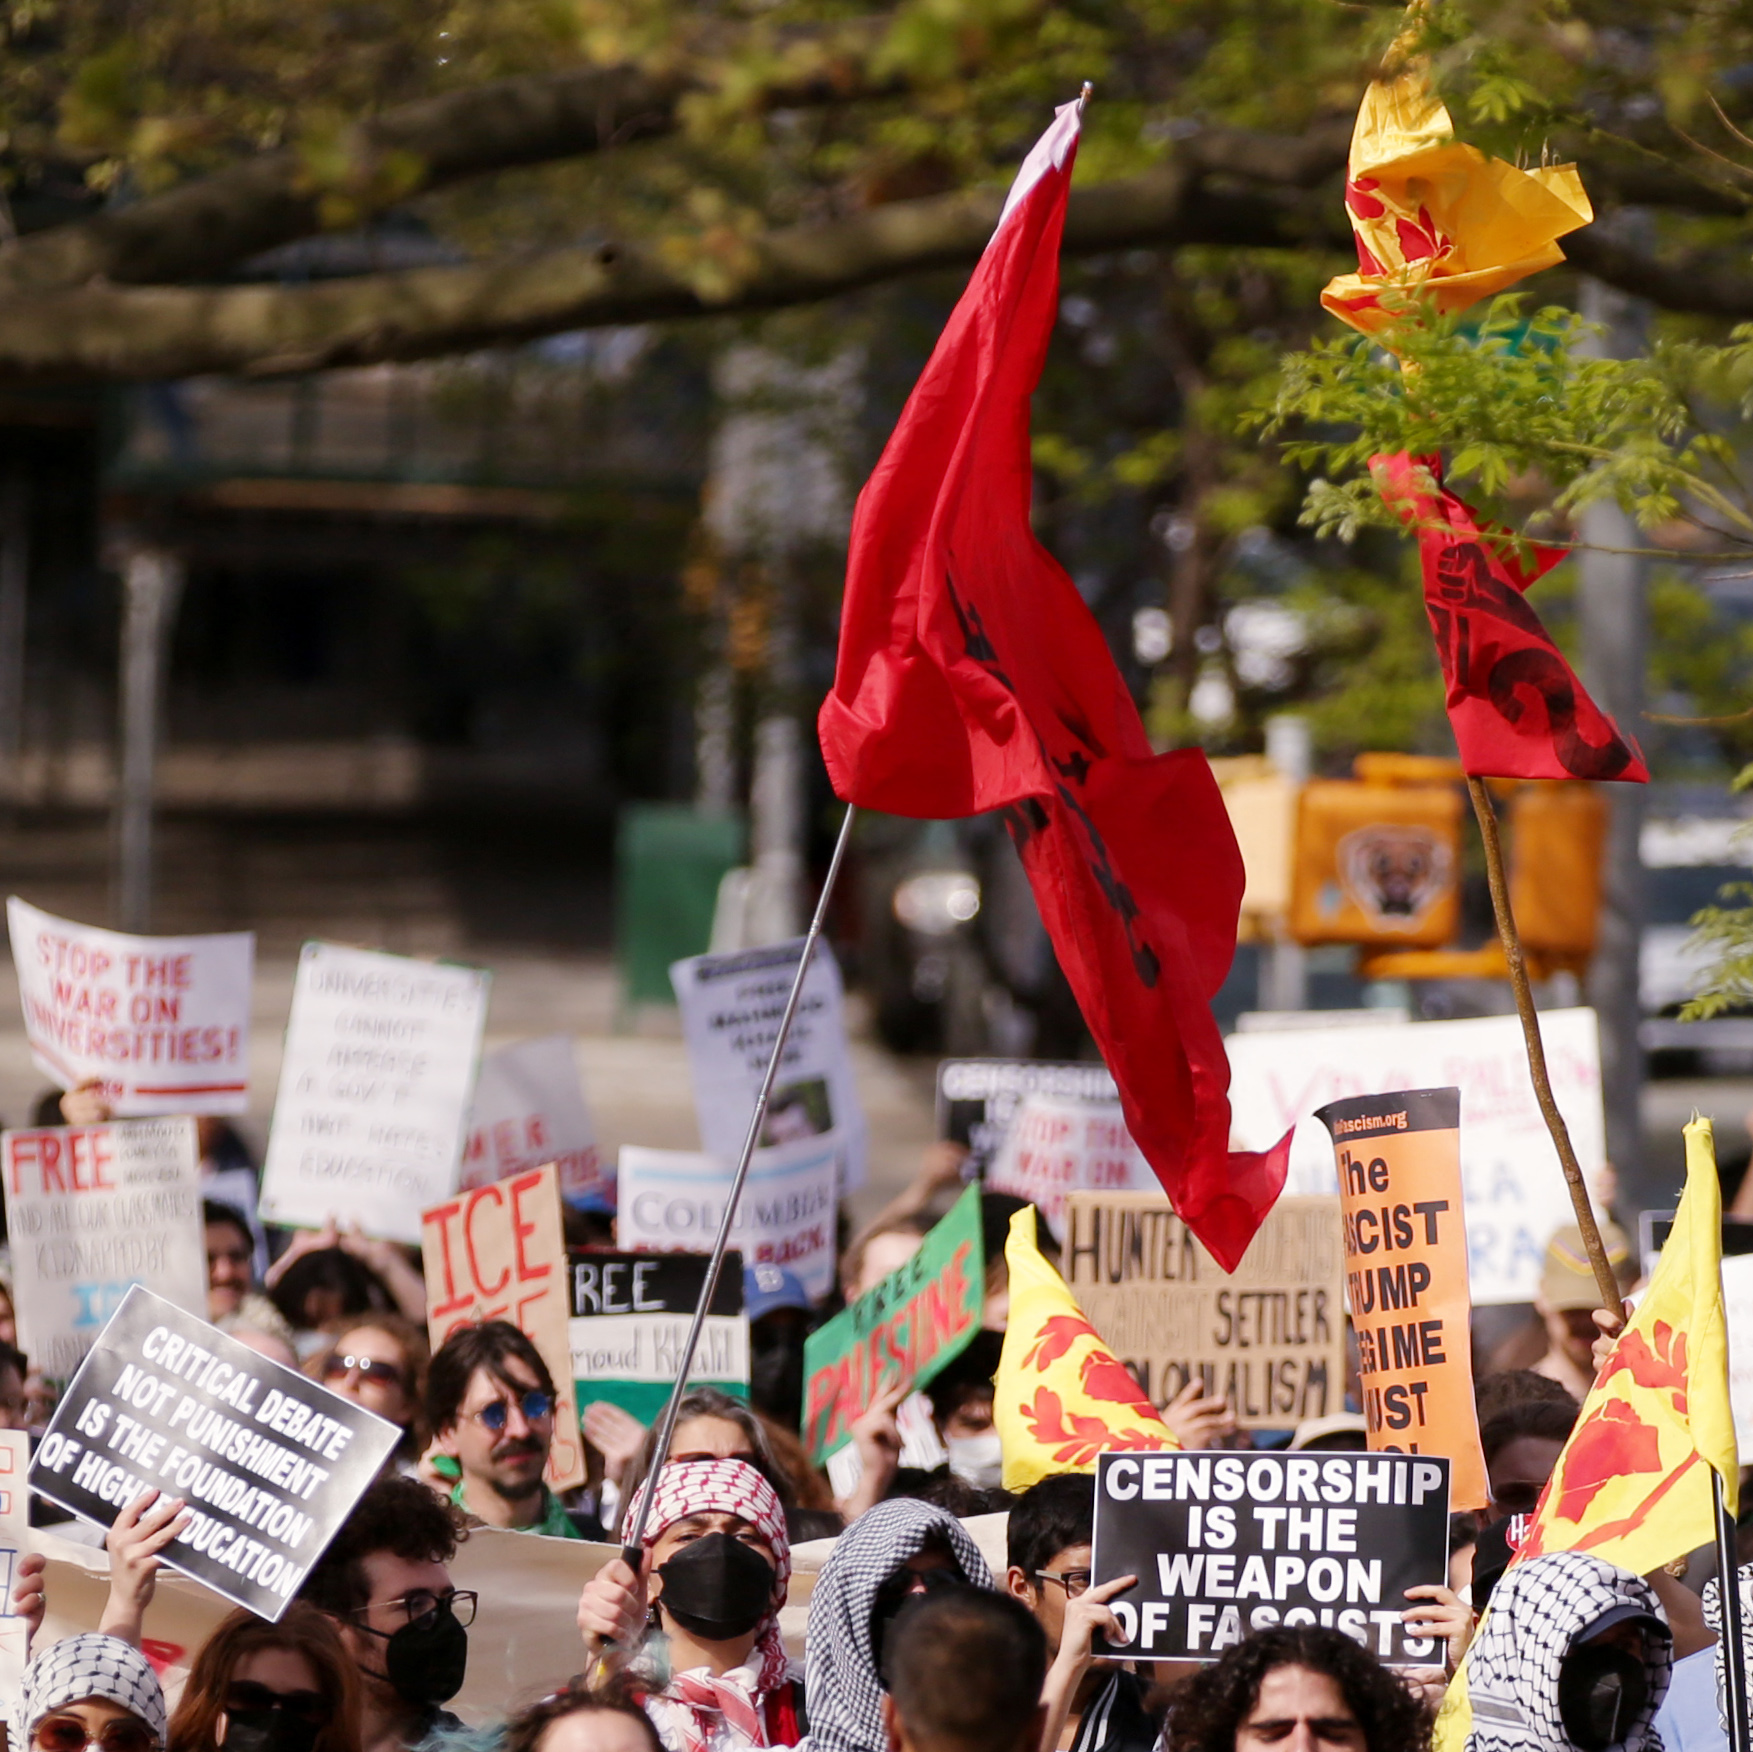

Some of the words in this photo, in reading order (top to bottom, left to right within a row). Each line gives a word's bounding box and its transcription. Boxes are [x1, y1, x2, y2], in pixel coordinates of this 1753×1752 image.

[124, 952, 193, 990] THE
[130, 993, 181, 1025] ON
[8, 1126, 116, 1196] FREE
[421, 1170, 552, 1318] ICE
[574, 1260, 668, 1314] REE
[1212, 1288, 1332, 1348] SETTLER
[142, 1326, 260, 1412] CRITICAL
[254, 1389, 354, 1462] DEBATE
[38, 1431, 83, 1474] OF
[110, 1362, 177, 1418] NOT
[167, 1395, 330, 1500] PUNISHMENT
[74, 1398, 112, 1438] IS
[106, 1412, 167, 1469] THE
[158, 1445, 314, 1548] FOUNDATION
[1105, 1457, 1443, 1506] CENSORSHIP
[1187, 1505, 1237, 1549] IS
[1253, 1506, 1358, 1553] THE
[1157, 1553, 1382, 1604] WEAPON
[1113, 1600, 1168, 1650] OF
